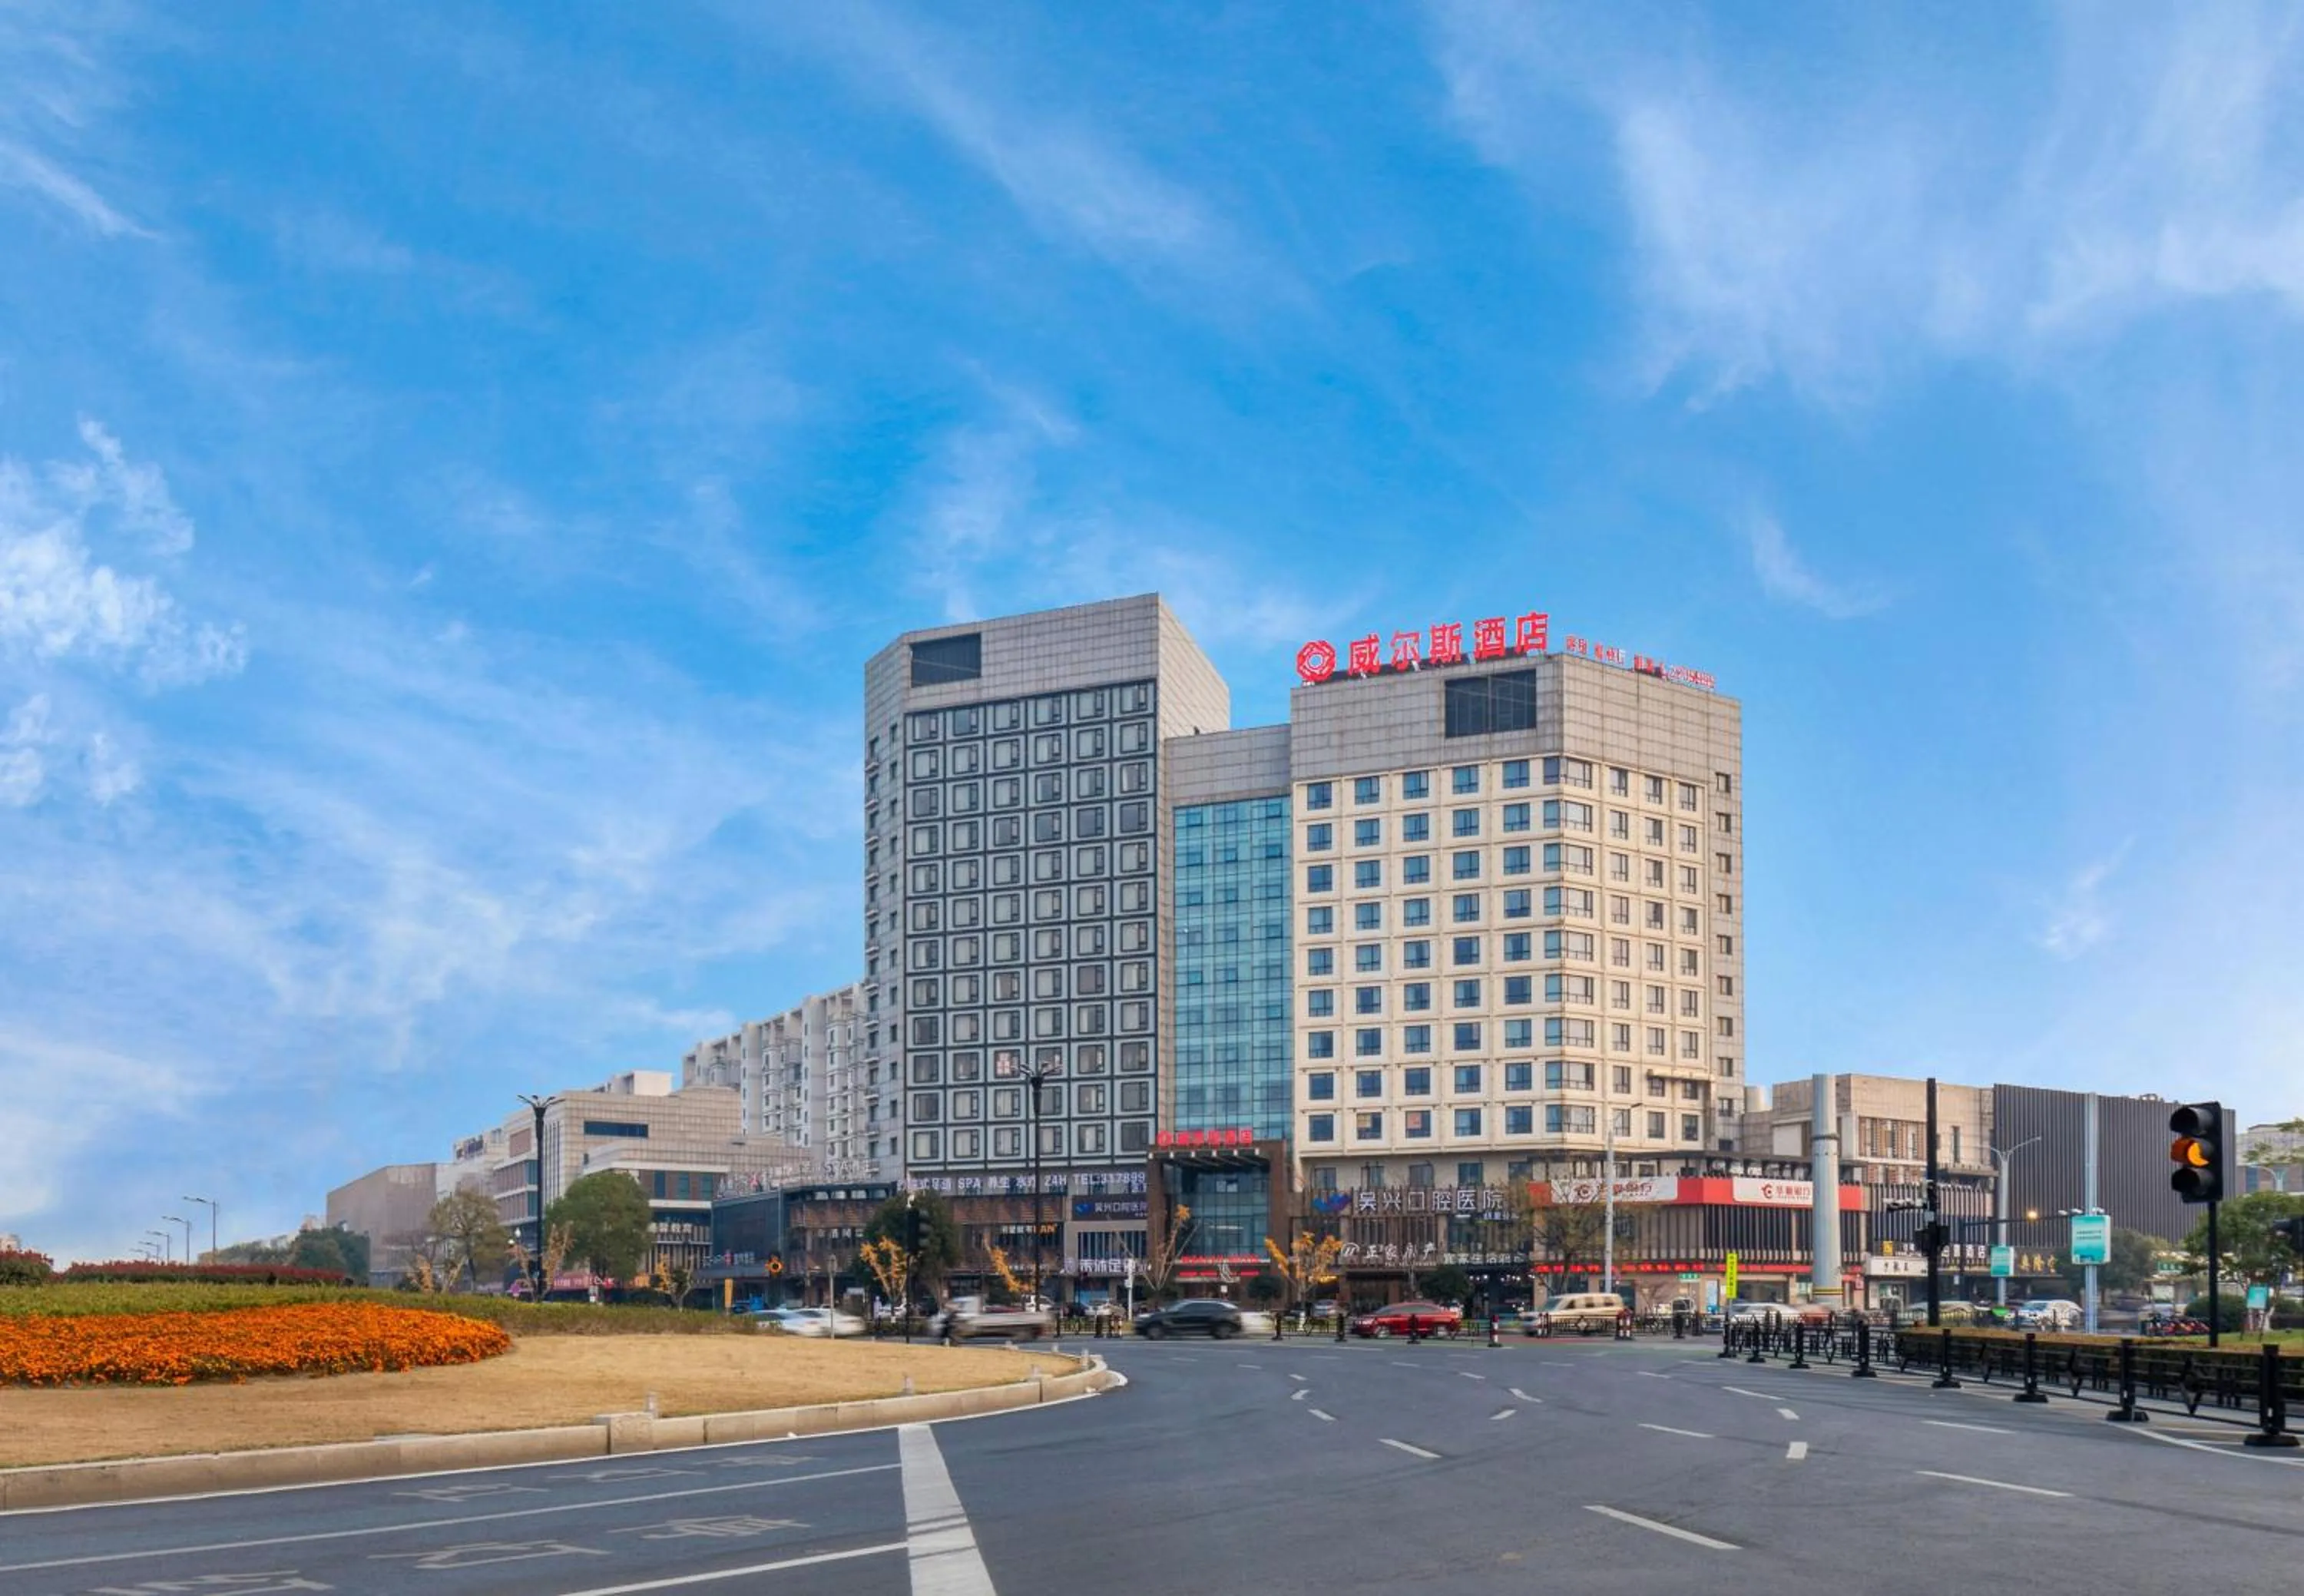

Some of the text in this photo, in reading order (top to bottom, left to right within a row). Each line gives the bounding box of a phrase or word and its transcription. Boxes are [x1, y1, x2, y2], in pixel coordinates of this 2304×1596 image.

[1348, 612, 1549, 674] 威尔斯酒店
[958, 1177, 982, 1190] SPA
[1044, 1174, 1068, 1187] 24H
[1359, 1190, 1505, 1211] 吴兴口腔医院
